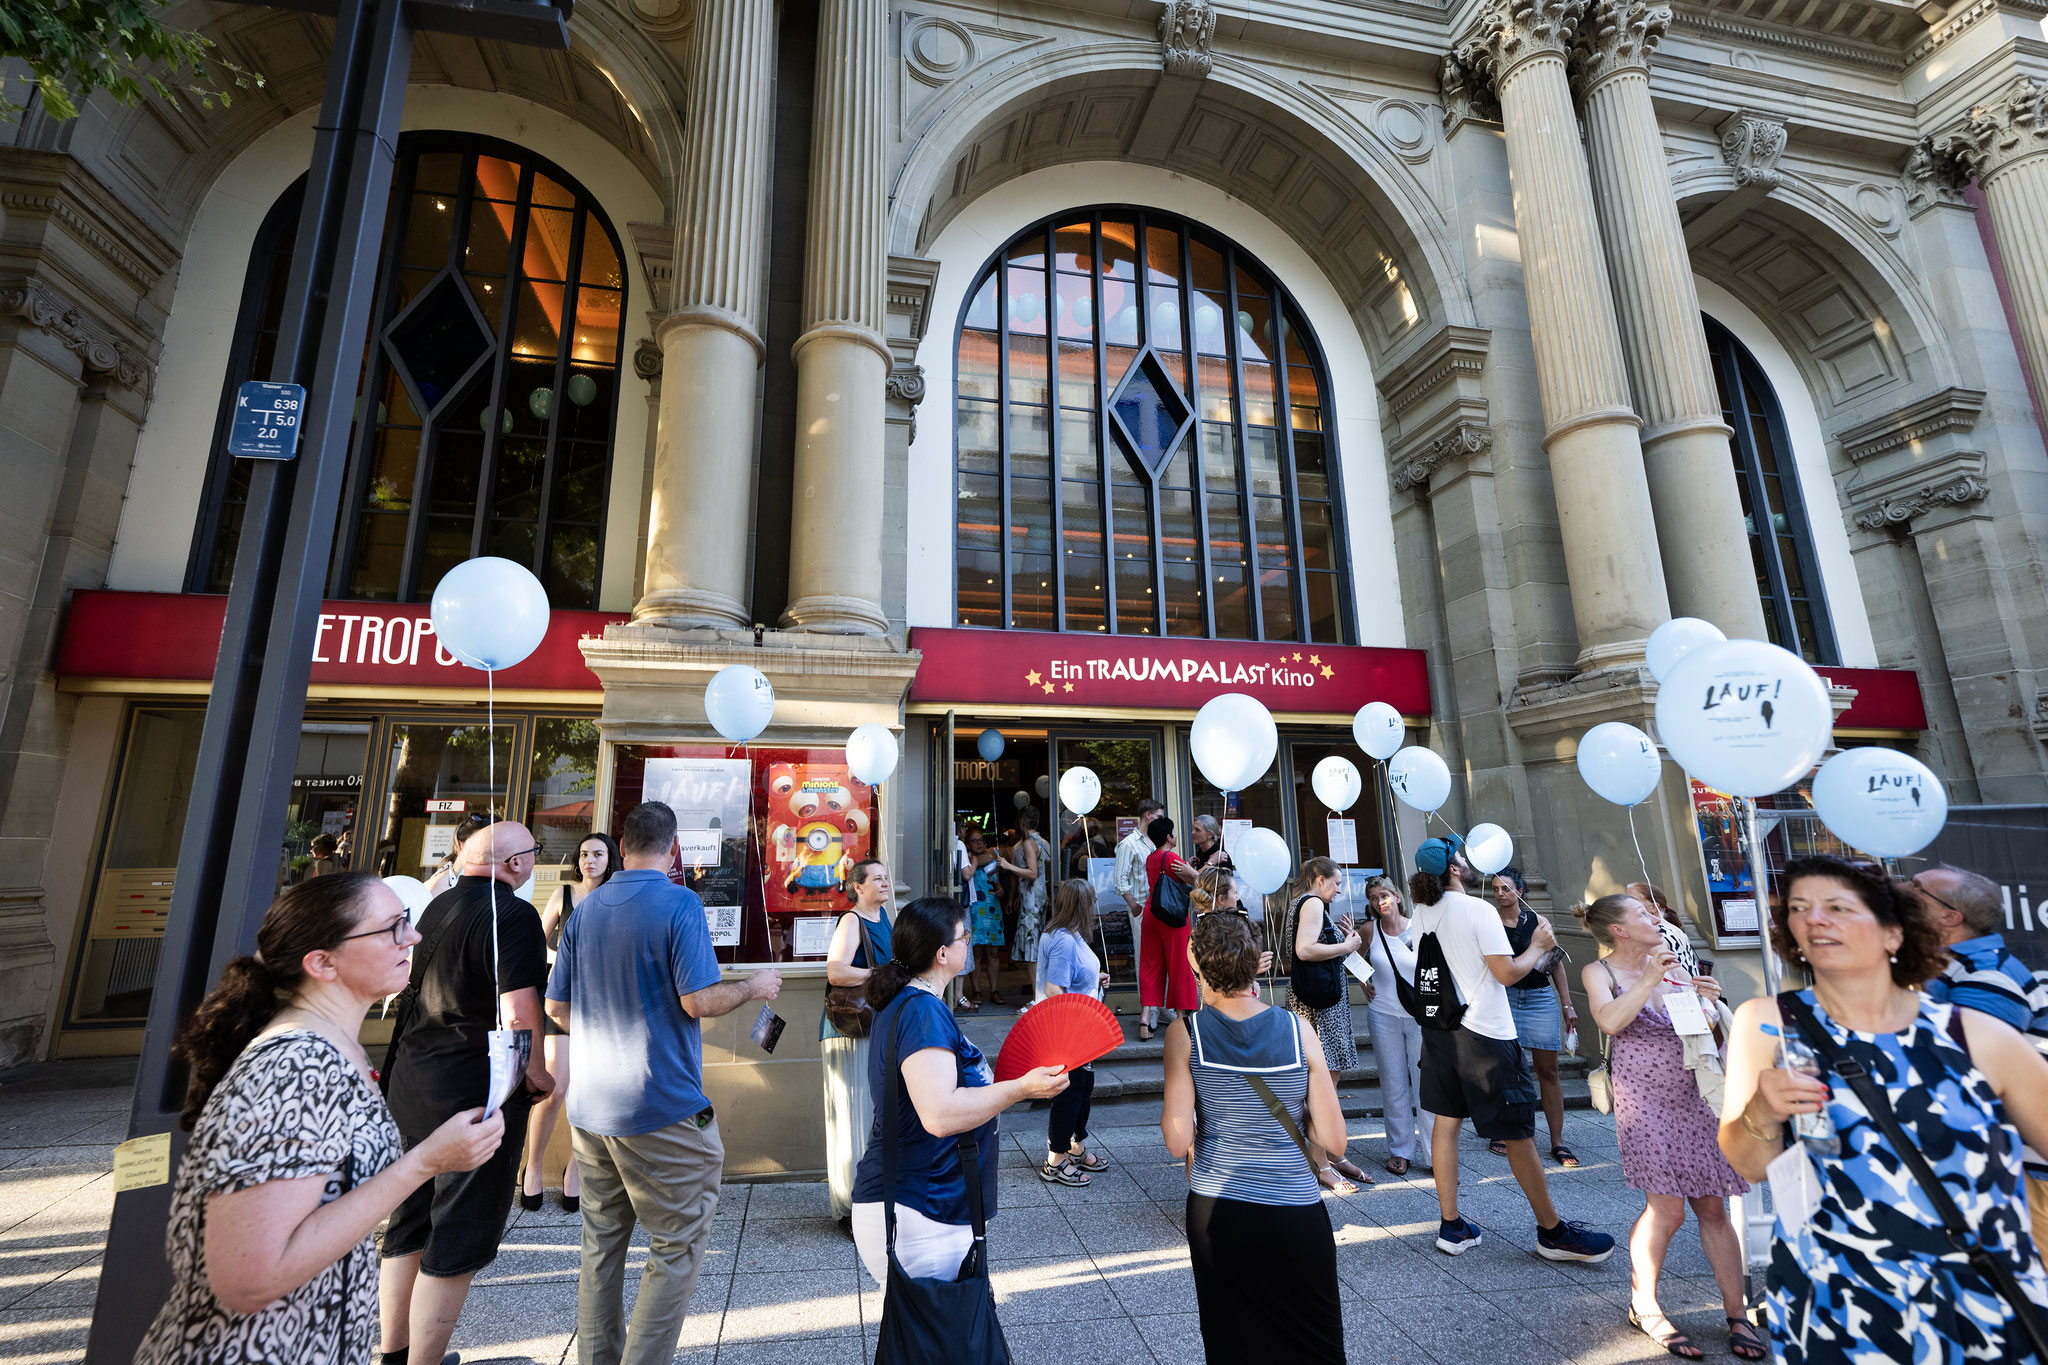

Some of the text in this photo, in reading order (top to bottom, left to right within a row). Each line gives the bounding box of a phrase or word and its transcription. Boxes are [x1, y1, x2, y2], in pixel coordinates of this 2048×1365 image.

[239, 396, 249, 408] K
[273, 398, 299, 411] 638
[312, 614, 470, 667] ETROP
[1050, 660, 1083, 680] Ein
[1271, 667, 1316, 688] Kino
[1702, 679, 1782, 710] LAUF!
[801, 781, 839, 789] minions
[1868, 772, 1922, 793] LAUF!
[438, 801, 453, 811] FIZ
[681, 844, 717, 852] sverkauft
